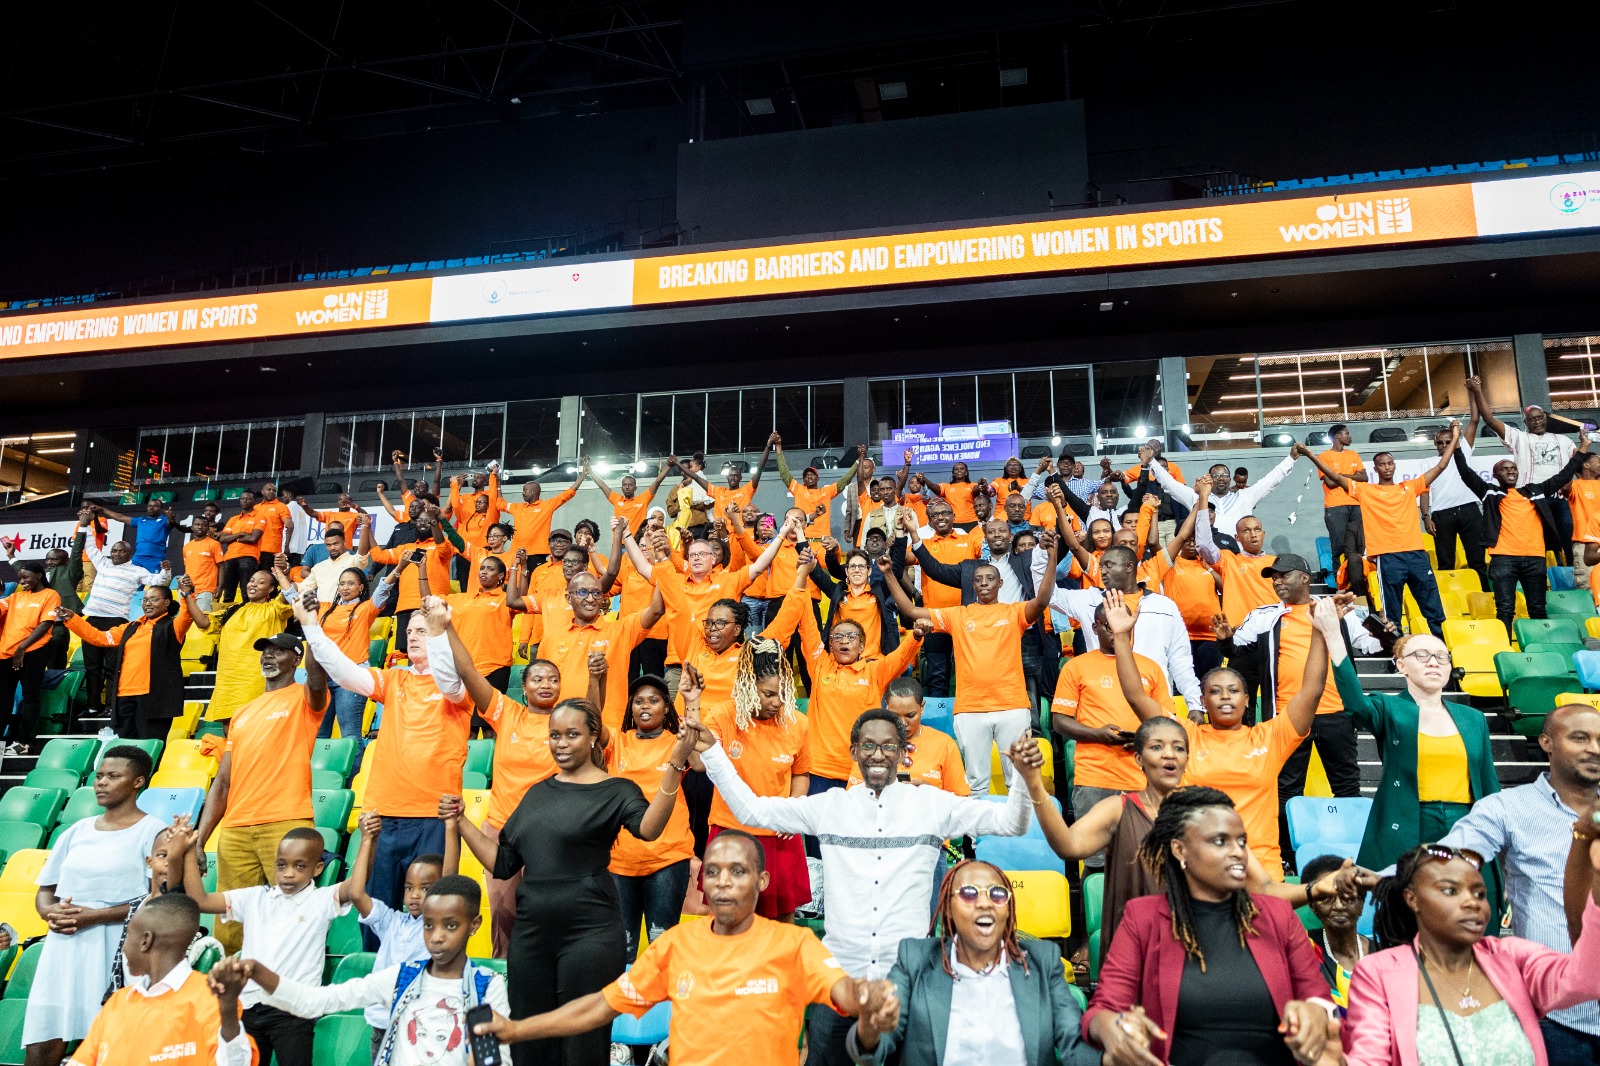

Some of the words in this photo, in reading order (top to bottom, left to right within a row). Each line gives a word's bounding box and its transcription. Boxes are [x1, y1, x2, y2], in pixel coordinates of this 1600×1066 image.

[1339, 200, 1374, 221] UN
[1279, 218, 1376, 243] WOMEN
[659, 258, 749, 288] BREAKING
[754, 250, 846, 281] BARRIERS
[849, 246, 889, 273] AND
[894, 236, 1025, 269] EMPOWERING
[1031, 227, 1110, 257] WOMEN
[1115, 225, 1138, 250] IN
[1142, 217, 1223, 248] SPORTS
[338, 290, 363, 307] UN
[25, 315, 119, 345] EMPOWERING
[123, 310, 178, 336] WOMEN
[181, 309, 198, 331] IN
[200, 303, 259, 329] SPORTS
[296, 305, 363, 326] WOMEN
[1327, 805, 1338, 814] 01
[1012, 880, 1024, 889] 04
[735, 986, 767, 996] WOMEN
[149, 1049, 184, 1063] WOMEN
